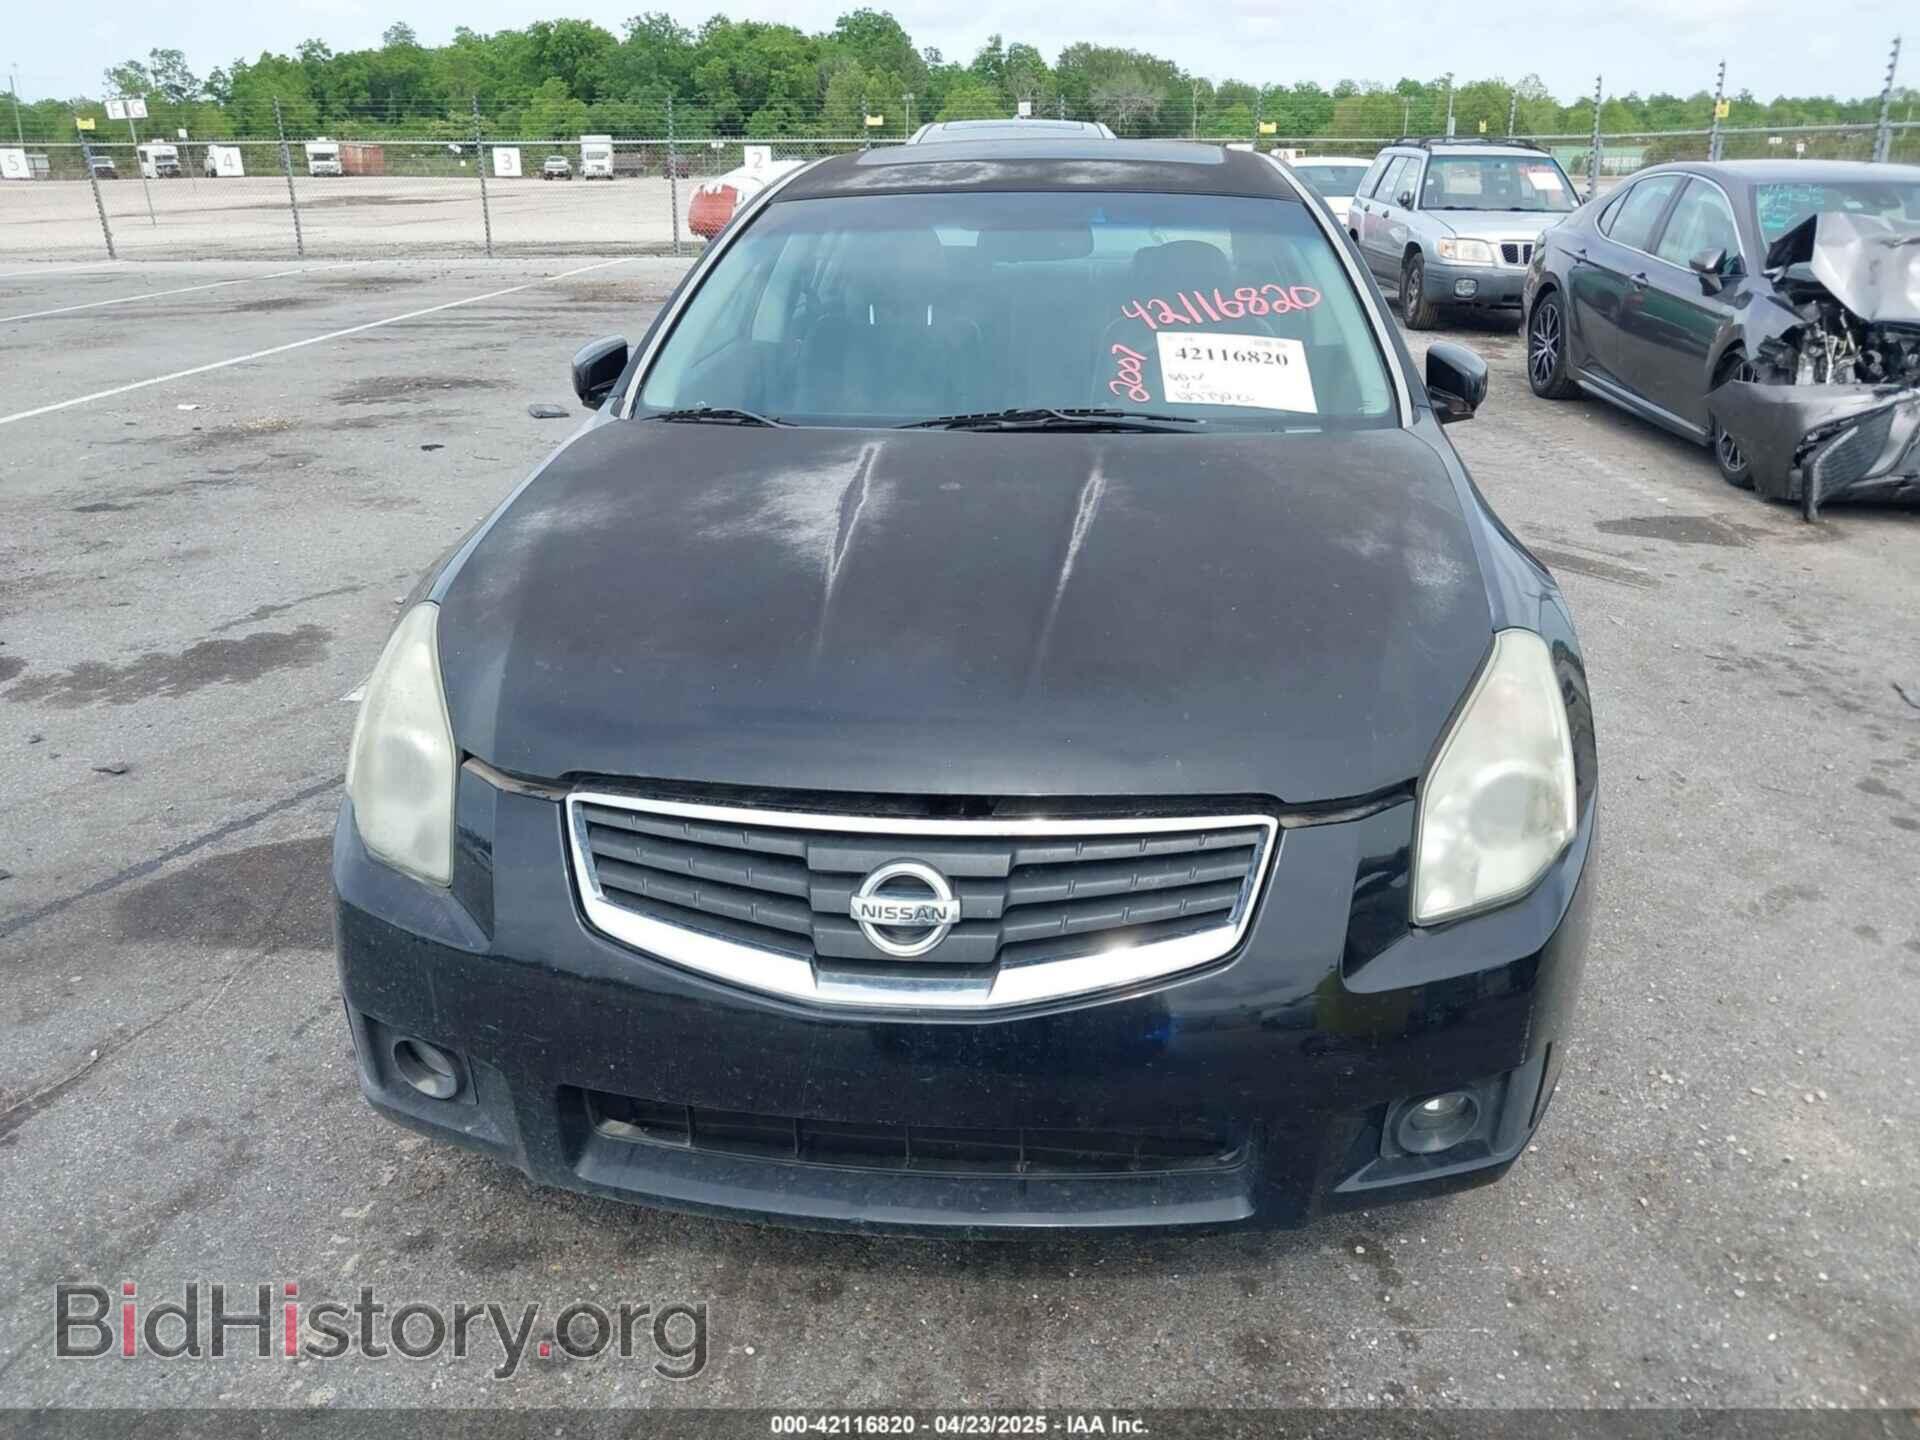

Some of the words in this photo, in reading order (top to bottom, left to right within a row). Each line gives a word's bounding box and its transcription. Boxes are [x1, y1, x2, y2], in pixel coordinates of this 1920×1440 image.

[131, 101, 145, 116] G
[8, 154, 20, 171] 5
[223, 153, 235, 170] 4
[502, 153, 513, 171] 3
[752, 152, 763, 169] 2
[1121, 284, 1321, 330] 42116820
[1175, 347, 1289, 367] 42116820
[1109, 343, 1150, 403] 2007
[861, 903, 948, 922] NISSAN
